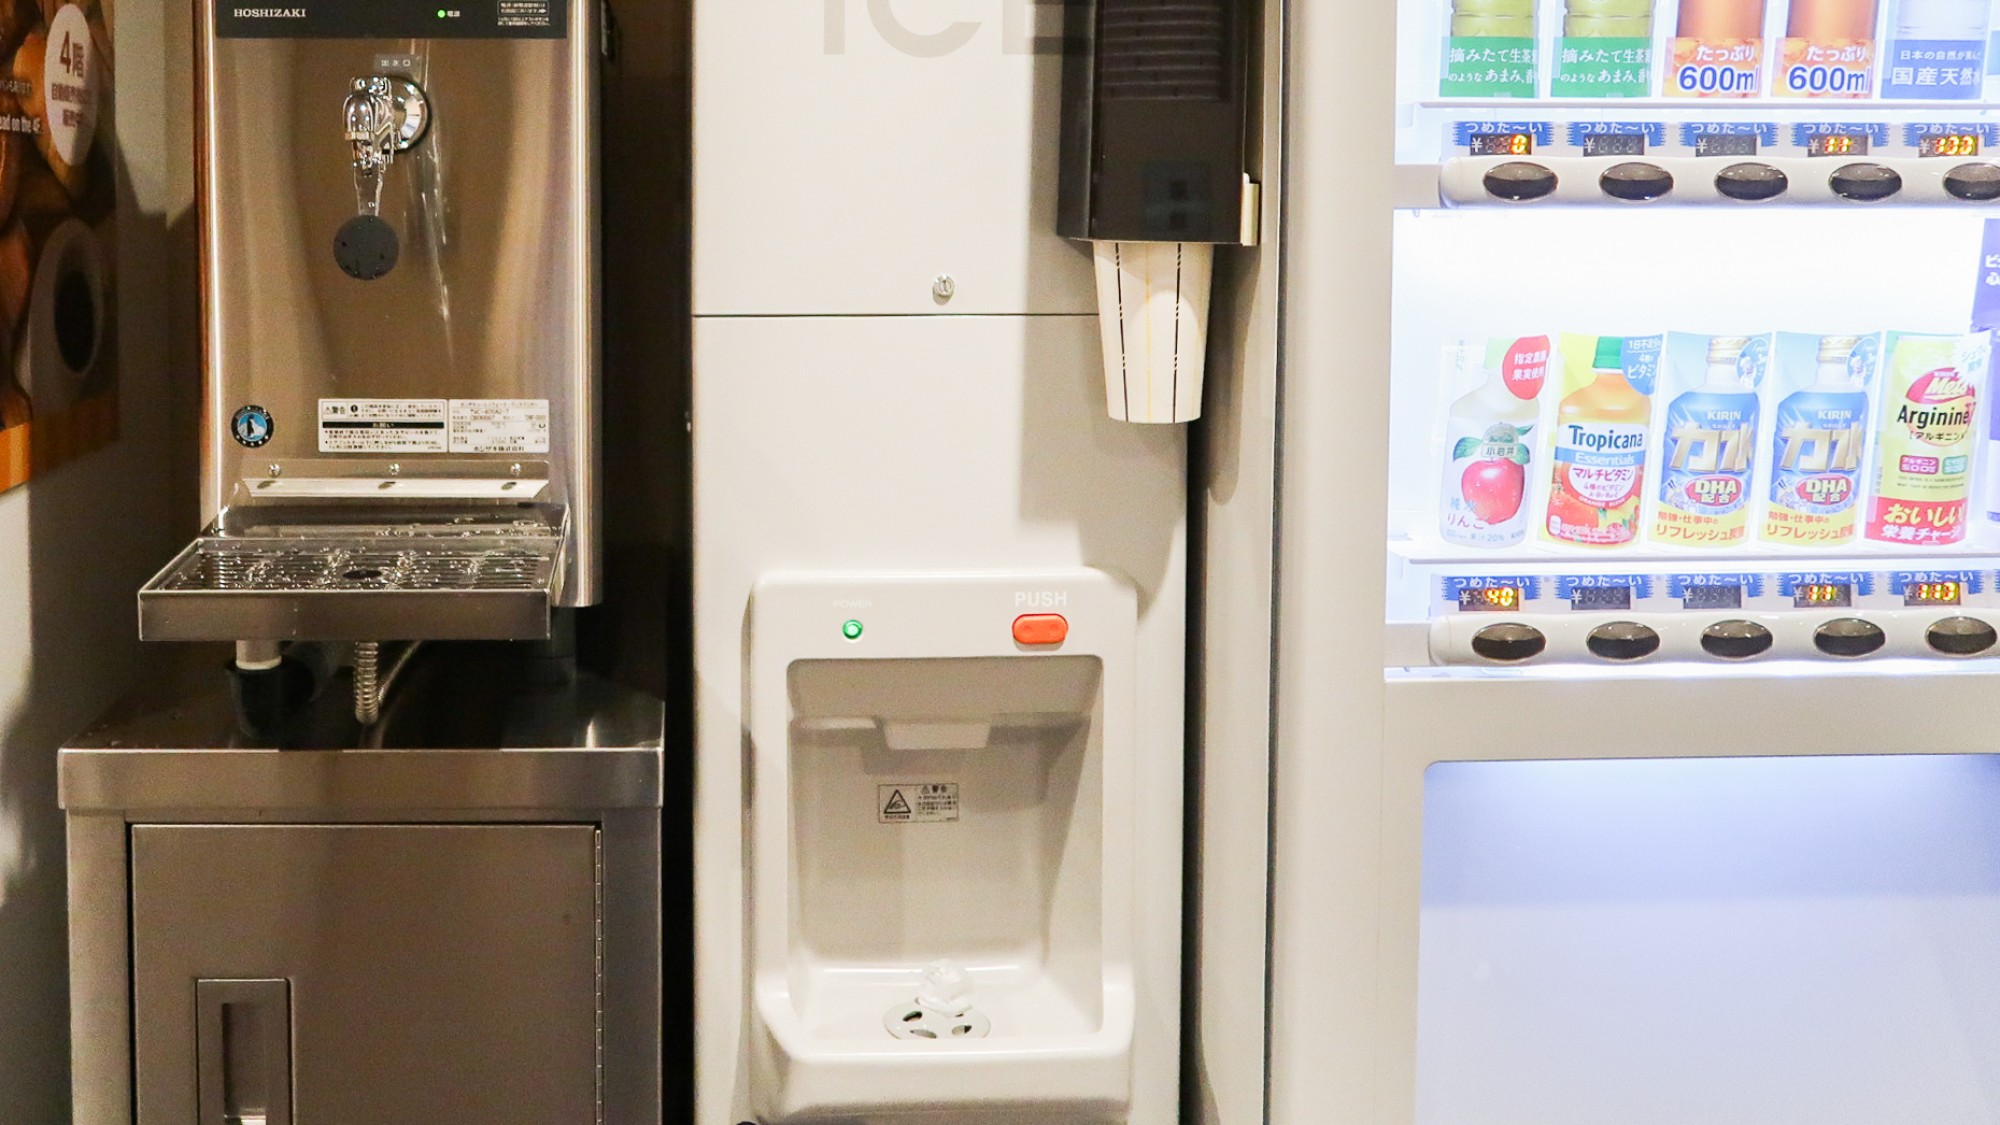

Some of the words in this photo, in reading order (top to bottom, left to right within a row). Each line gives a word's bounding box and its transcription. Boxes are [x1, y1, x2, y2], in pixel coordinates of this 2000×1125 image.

[233, 8, 307, 18] HOSHIZAKI
[1697, 45, 1755, 61] たっぷり
[1806, 45, 1866, 61] たっぷり
[1678, 65, 1760, 92] 600ml
[1788, 65, 1869, 92] 600ml
[1707, 410, 1742, 420] KIRIN
[1817, 409, 1853, 420] KIRIN
[1896, 404, 1970, 430] Arginine
[1567, 424, 1643, 452] Tropicana
[1575, 452, 1635, 466] Essentials
[1572, 467, 1634, 481] マルチビタミン
[1694, 480, 1738, 494] DHA
[1805, 479, 1848, 493] DHA
[1883, 503, 1966, 528] おいしい
[1014, 591, 1068, 607] PUSH
